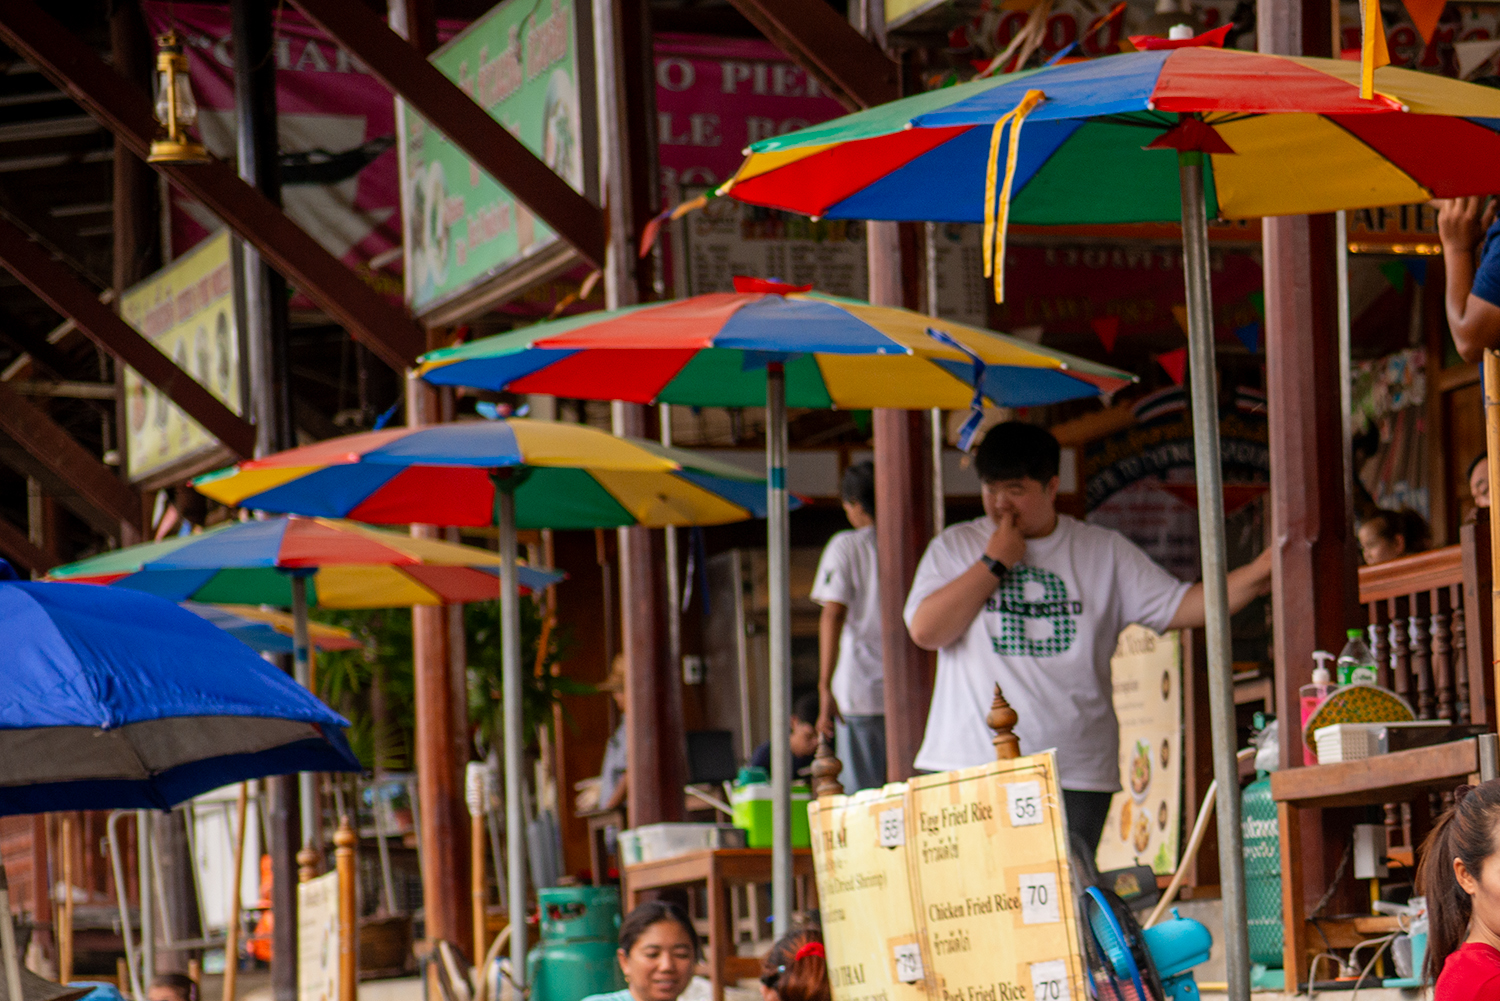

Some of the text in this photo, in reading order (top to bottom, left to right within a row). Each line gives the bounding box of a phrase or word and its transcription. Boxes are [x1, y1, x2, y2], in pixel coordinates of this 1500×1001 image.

[919, 801, 993, 836] Egg Fried Rice
[1015, 797, 1036, 819] 55
[884, 819, 898, 840] 55
[1027, 884, 1048, 906] 70
[928, 893, 1020, 922] Chicken Fried Rice
[998, 981, 1027, 1001] Rice
[1040, 980, 1060, 1001] 70
